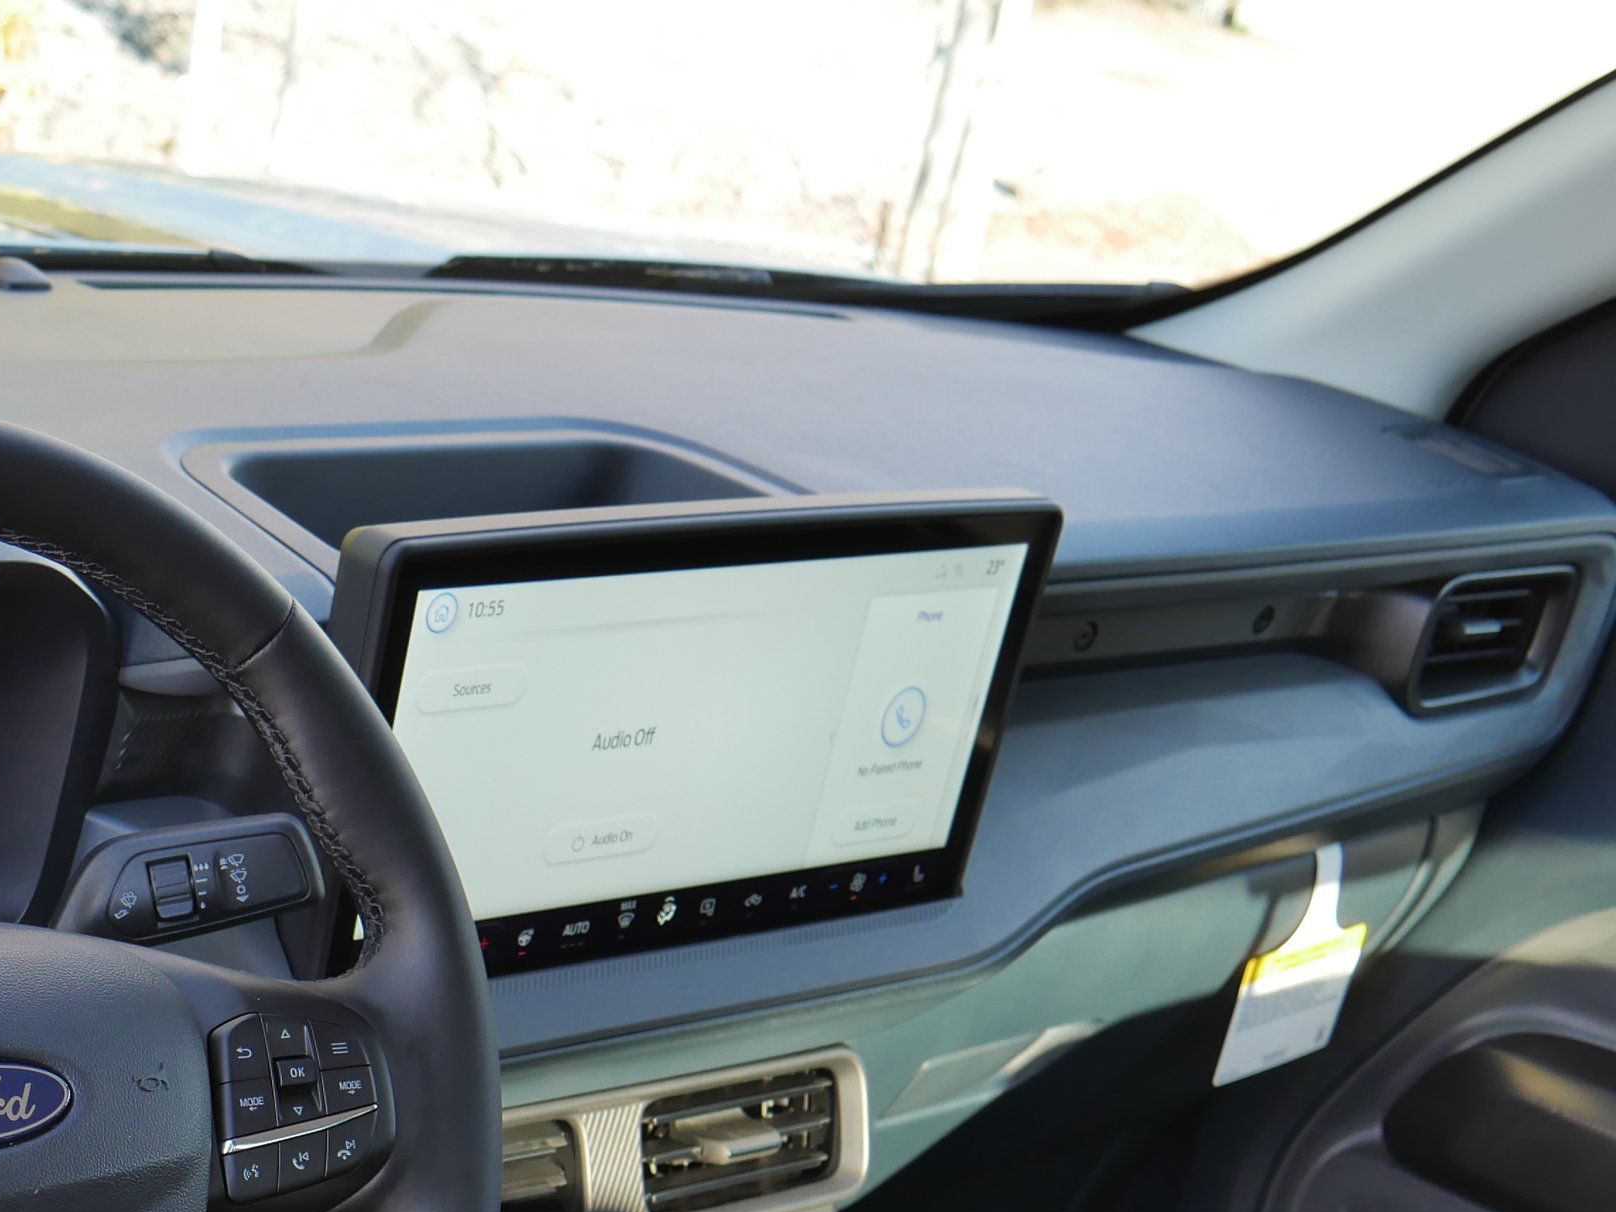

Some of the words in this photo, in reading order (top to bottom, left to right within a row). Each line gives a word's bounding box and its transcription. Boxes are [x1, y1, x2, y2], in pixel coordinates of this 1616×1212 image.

[467, 600, 505, 618] 10:55
[916, 610, 944, 623] Phone
[452, 681, 492, 697] Sources
[591, 731, 632, 751] Audio
[634, 726, 657, 746] Off
[591, 832, 618, 846] Audio
[620, 830, 634, 842] On
[562, 921, 590, 937] AUTO
[289, 1067, 305, 1078] OK
[339, 1080, 362, 1091] MODE
[239, 1096, 264, 1107] MODE
